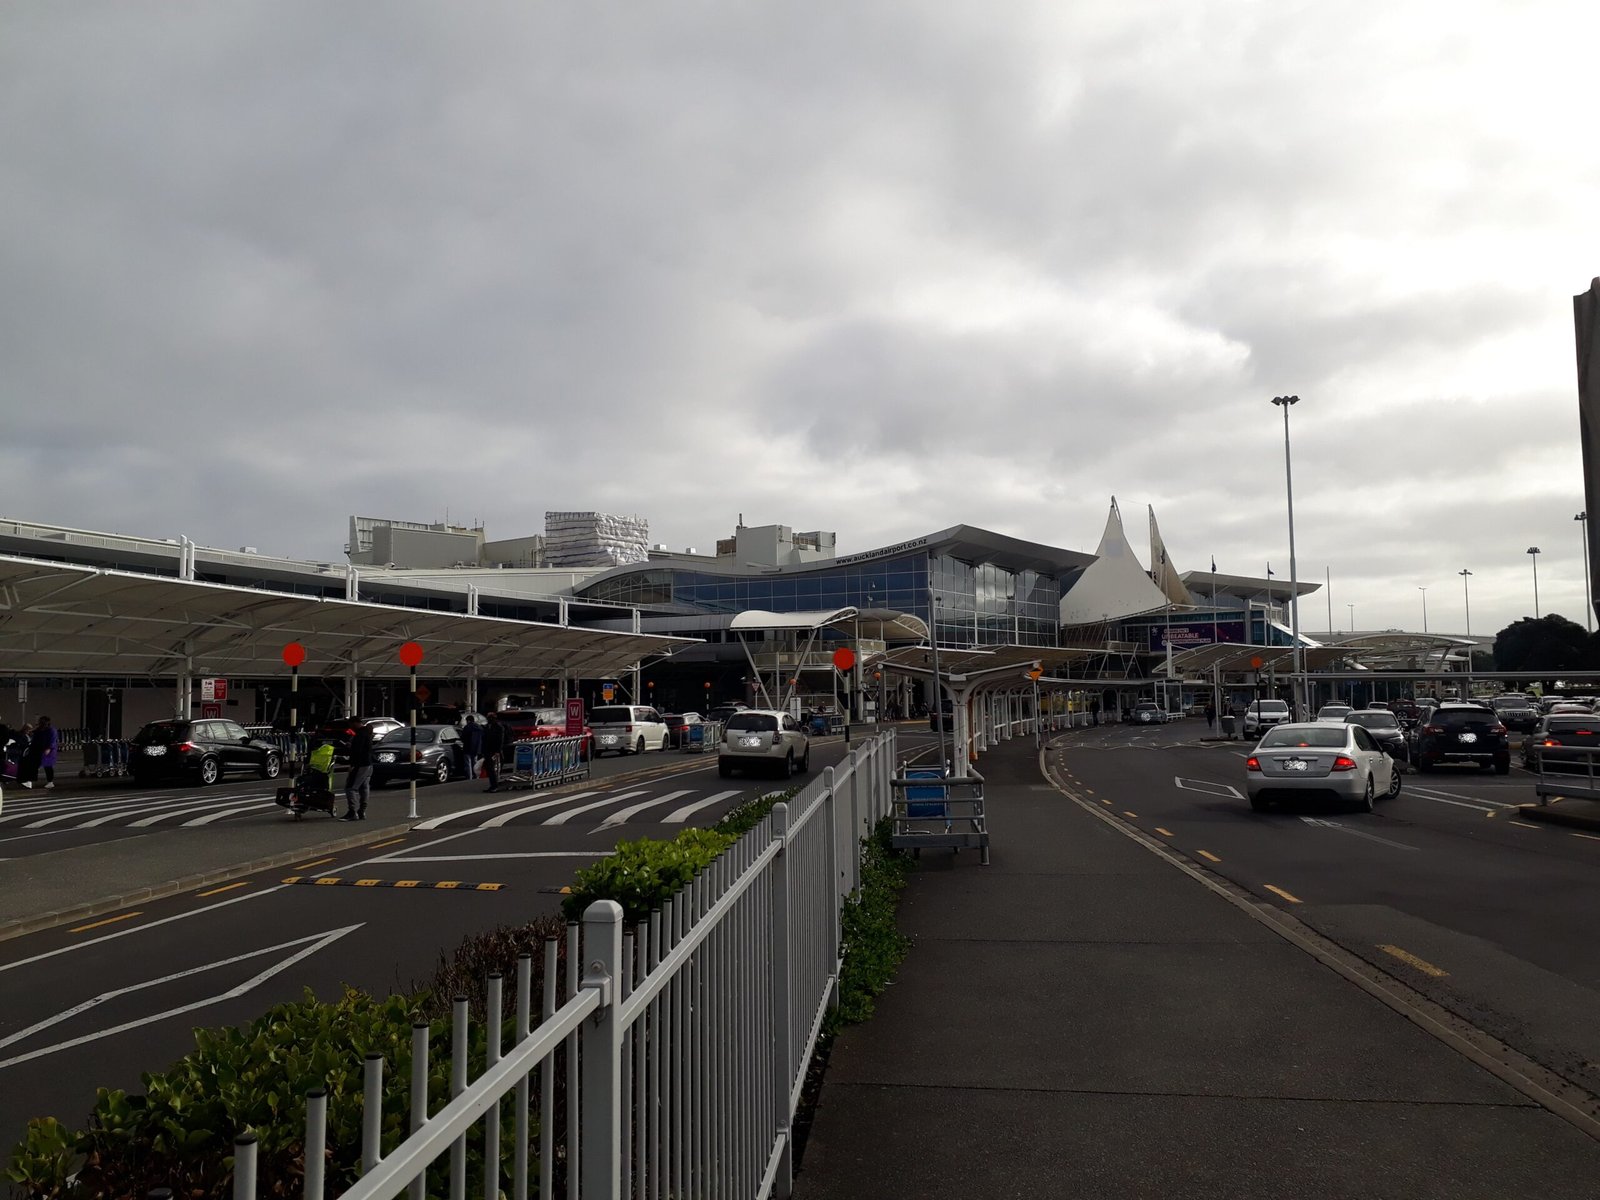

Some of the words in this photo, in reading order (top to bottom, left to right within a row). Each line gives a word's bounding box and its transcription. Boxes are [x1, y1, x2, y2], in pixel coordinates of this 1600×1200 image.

[836, 539, 927, 565] www.aucklandairport.co.nz
[206, 710, 216, 719] W
[570, 706, 579, 716] W
